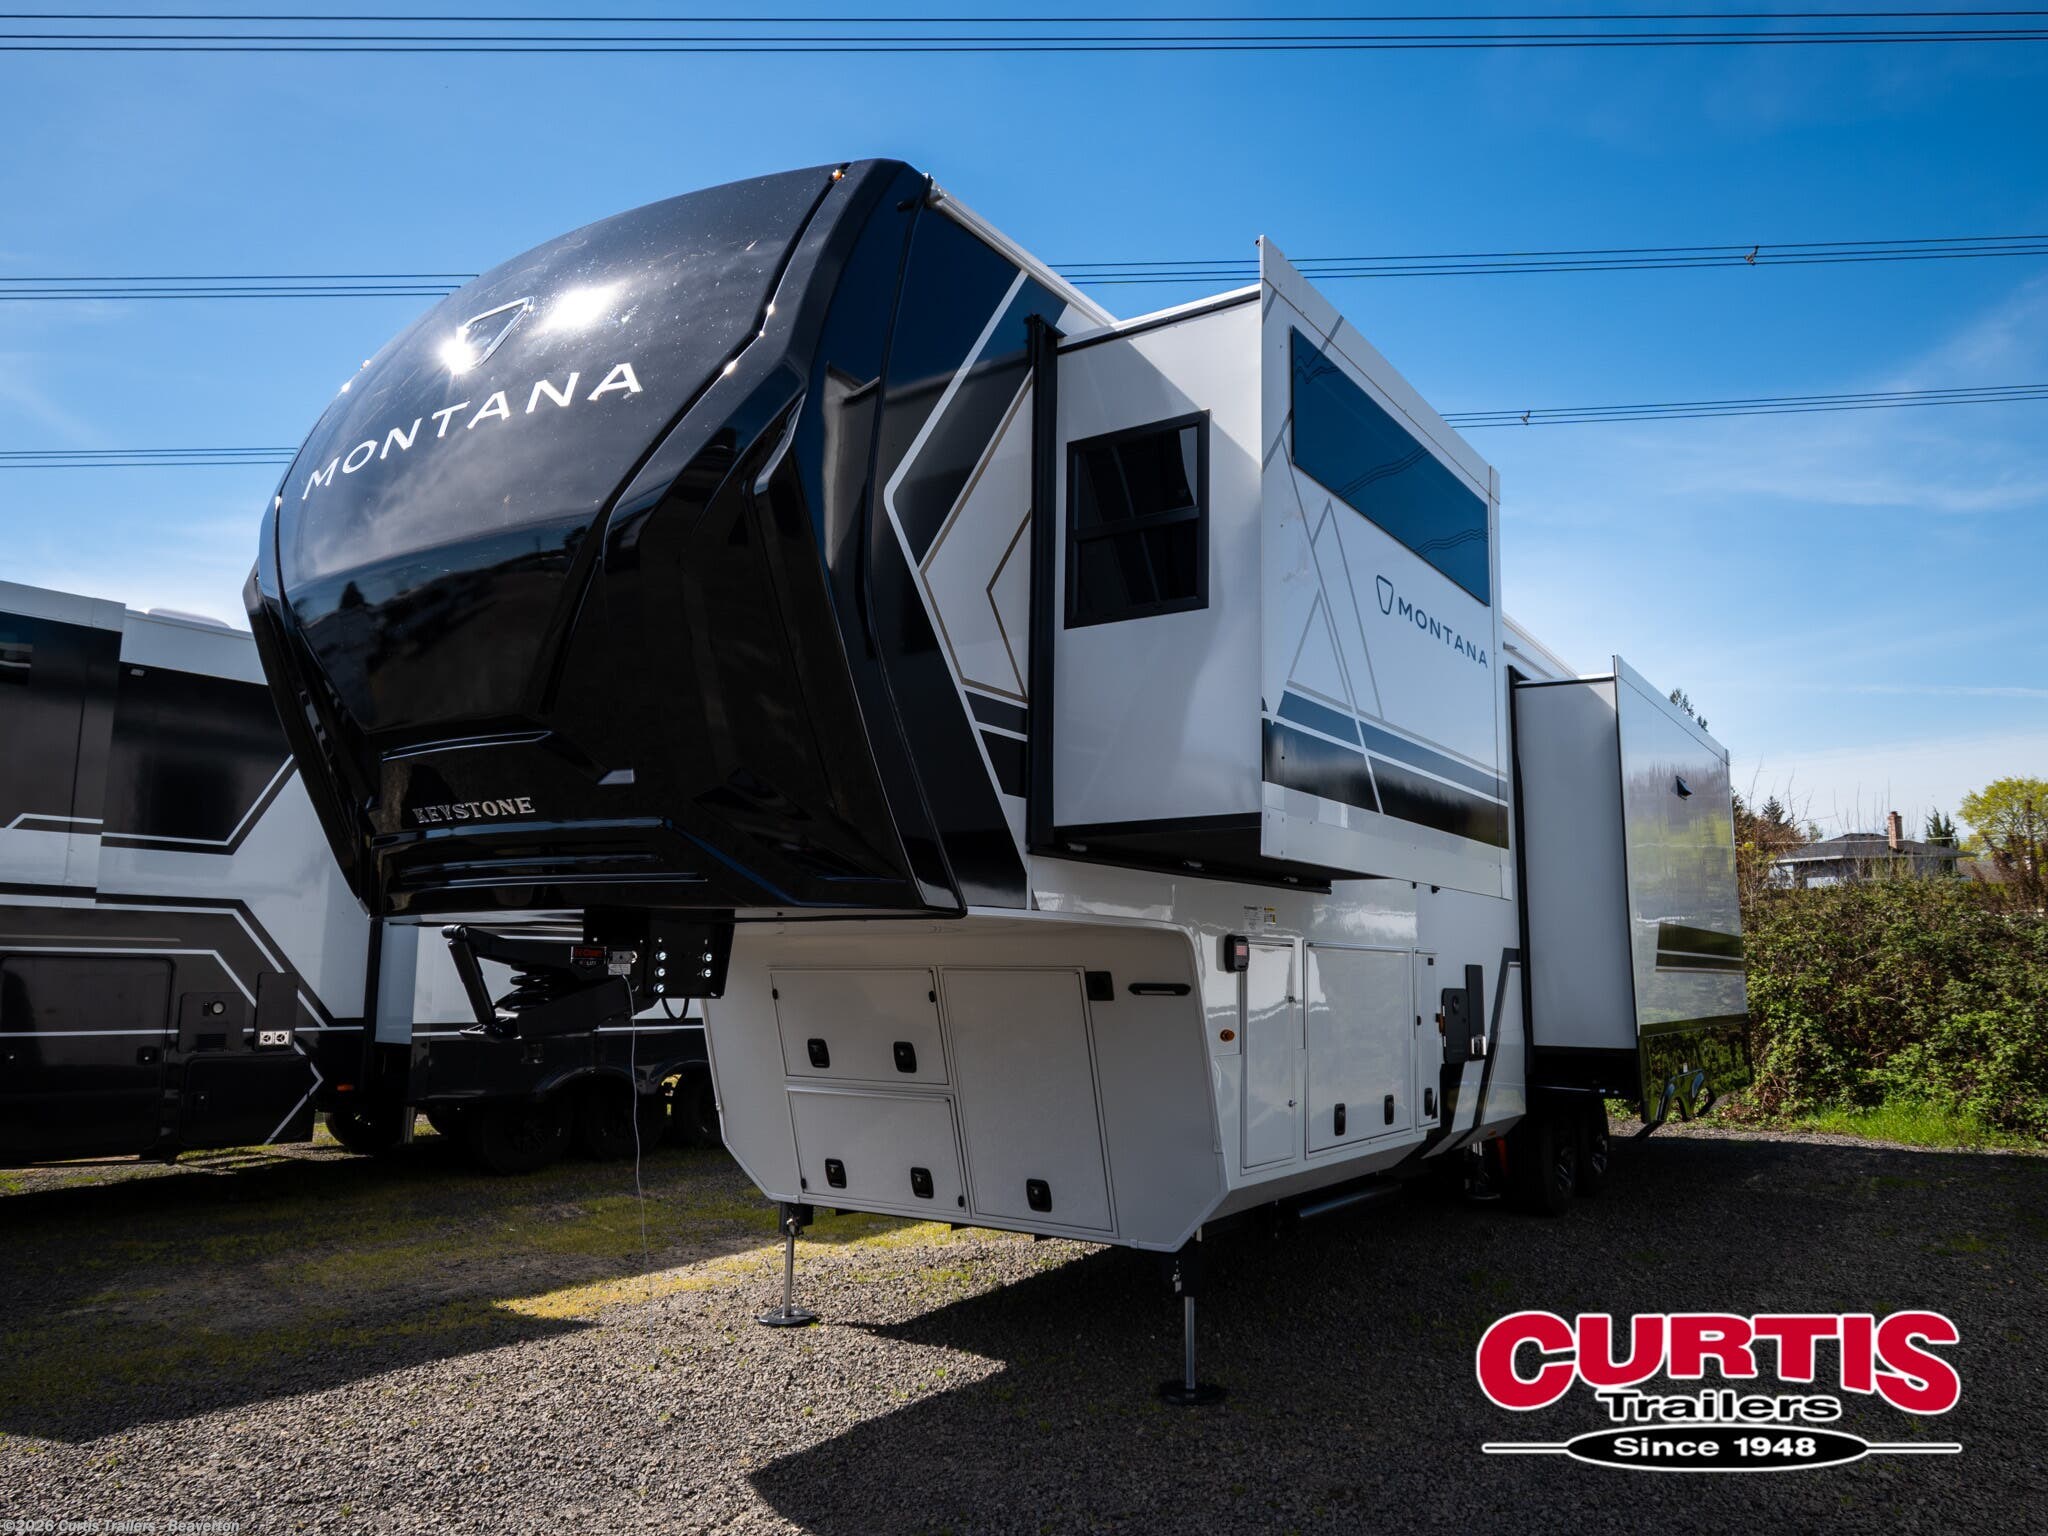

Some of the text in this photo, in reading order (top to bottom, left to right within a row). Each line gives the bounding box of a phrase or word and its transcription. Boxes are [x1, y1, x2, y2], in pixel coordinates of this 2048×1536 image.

[302, 362, 643, 499] MONTANA
[1398, 596, 1488, 669] MONTANA
[412, 797, 536, 824] KEYSTONE
